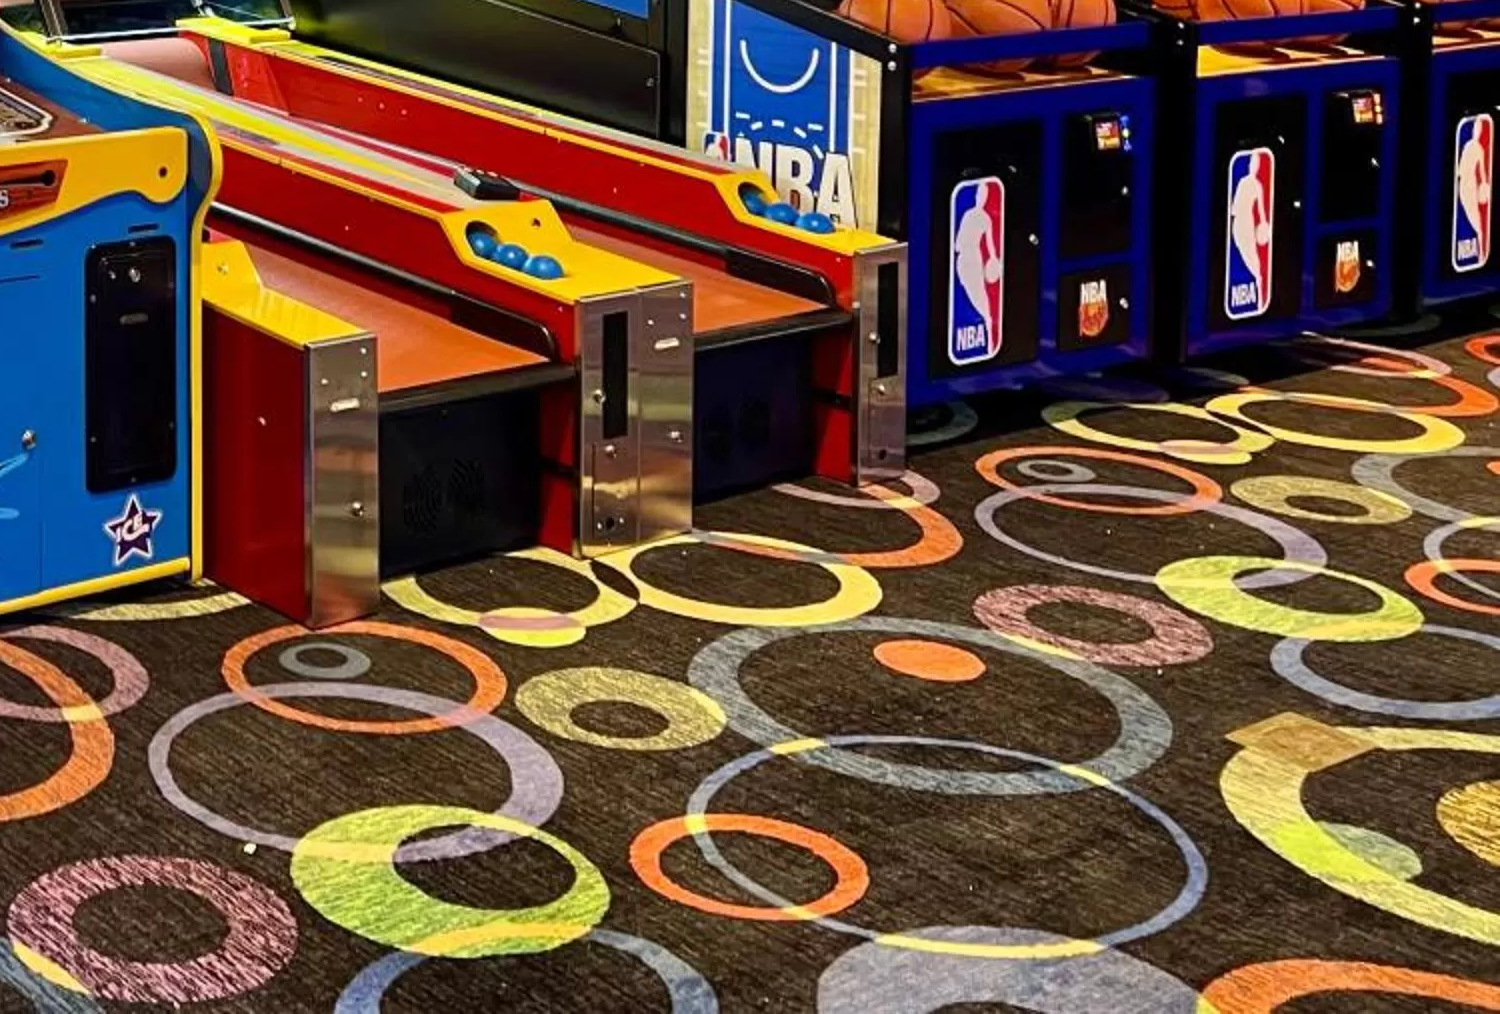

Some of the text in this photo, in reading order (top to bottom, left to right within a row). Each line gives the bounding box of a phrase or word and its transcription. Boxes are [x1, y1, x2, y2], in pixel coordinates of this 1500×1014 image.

[735, 137, 859, 230] NBA
[1081, 279, 1107, 305] NBA
[1231, 282, 1257, 307] NBA
[955, 324, 986, 351] NBA
[116, 514, 150, 543] ICE
